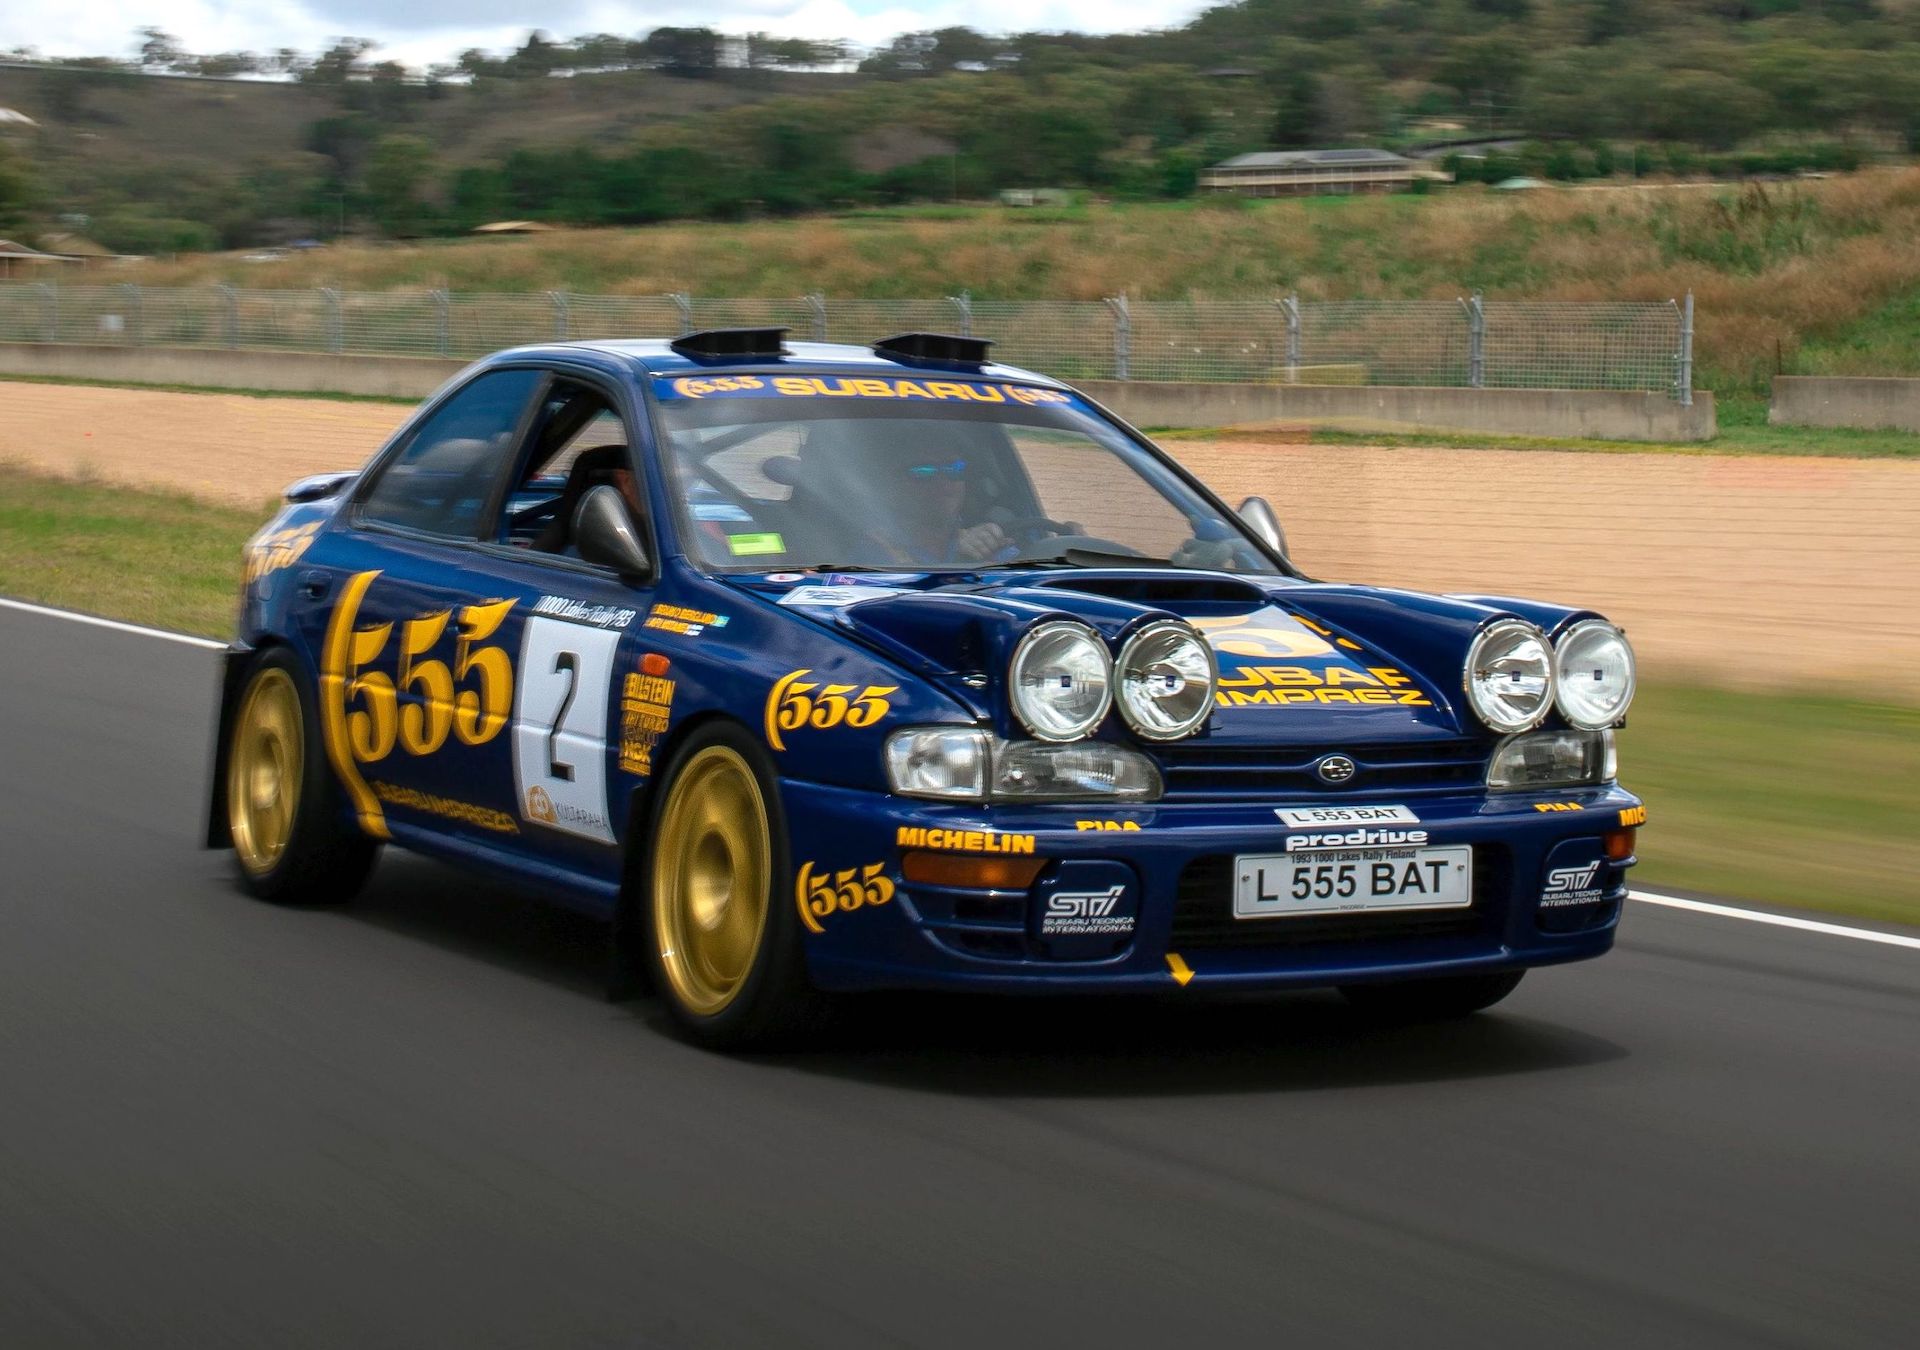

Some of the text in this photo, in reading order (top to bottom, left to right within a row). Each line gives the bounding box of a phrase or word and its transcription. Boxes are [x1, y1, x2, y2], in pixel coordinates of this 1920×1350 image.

[772, 377, 1006, 403] SUBARU
[561, 600, 592, 619] Lakes
[1215, 688, 1432, 706] IMPREZ
[549, 650, 581, 782] 2
[1534, 802, 1584, 812] PIAA
[1291, 811, 1309, 822] L
[1312, 809, 1351, 821] 555
[1355, 808, 1400, 820] BAT
[1075, 820, 1141, 832] PIAA
[897, 826, 1035, 854] MICHELIN
[1286, 828, 1428, 851] prodrive
[1291, 849, 1417, 864] 1993 1000 Lakes Rally Finland
[1257, 860, 1449, 902] L 555 BAT
[1540, 896, 1601, 907] INTERNATIONAL
[1541, 891, 1574, 901] SUBARU
[1043, 916, 1135, 926] SUBARU TECNICA
[1042, 924, 1134, 934] INTERNATIONAL
